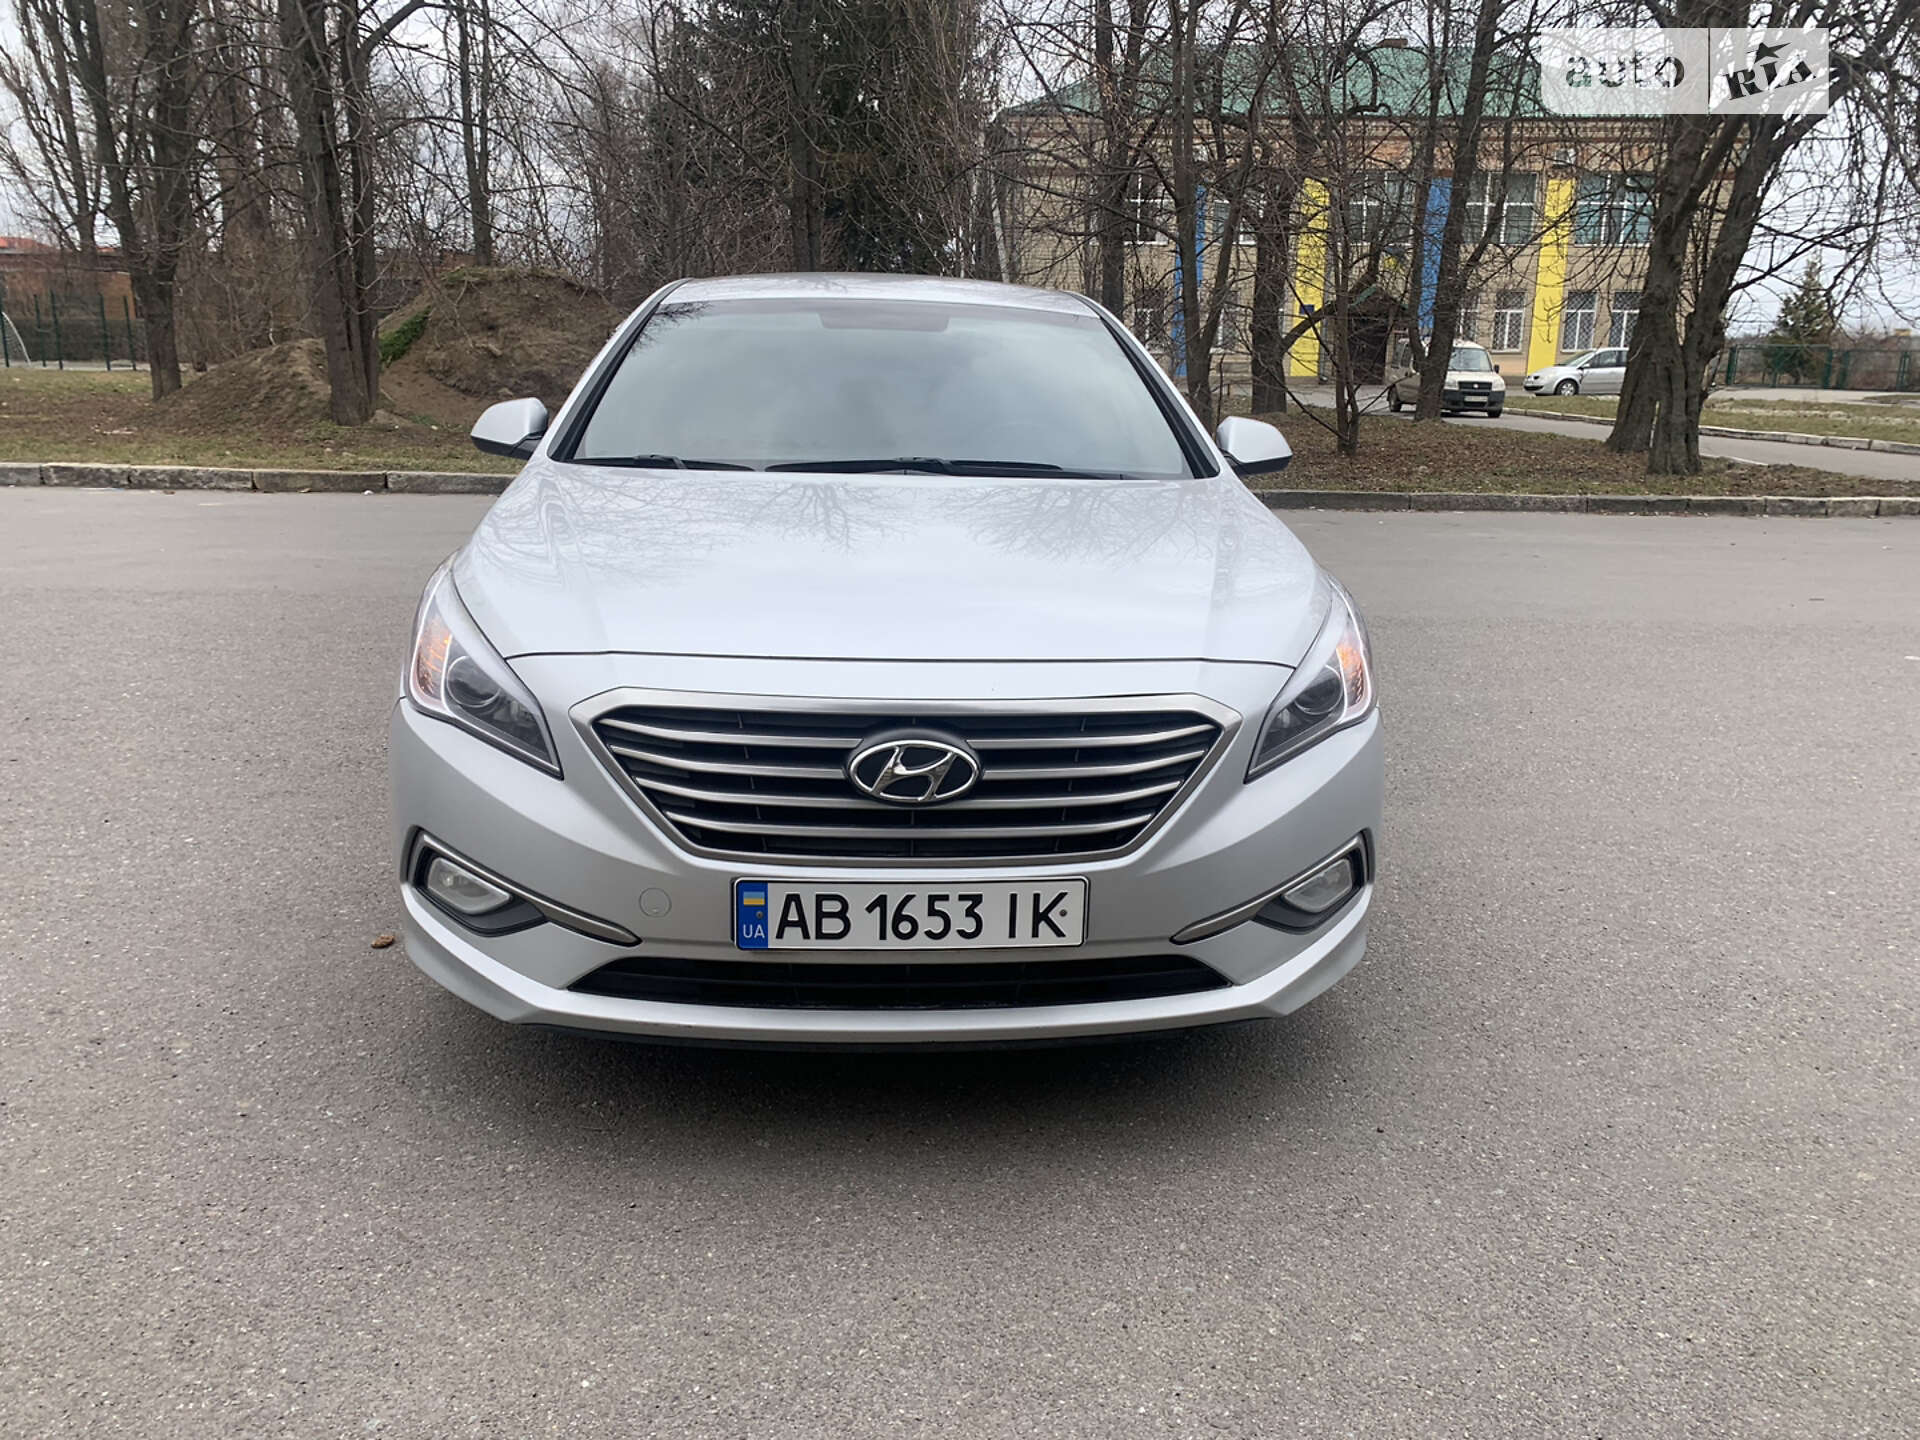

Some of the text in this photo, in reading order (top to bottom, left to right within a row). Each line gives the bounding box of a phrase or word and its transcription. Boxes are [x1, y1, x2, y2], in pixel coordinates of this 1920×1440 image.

[742, 924, 765, 939] UA
[775, 891, 1068, 941] AB 1653 IK
